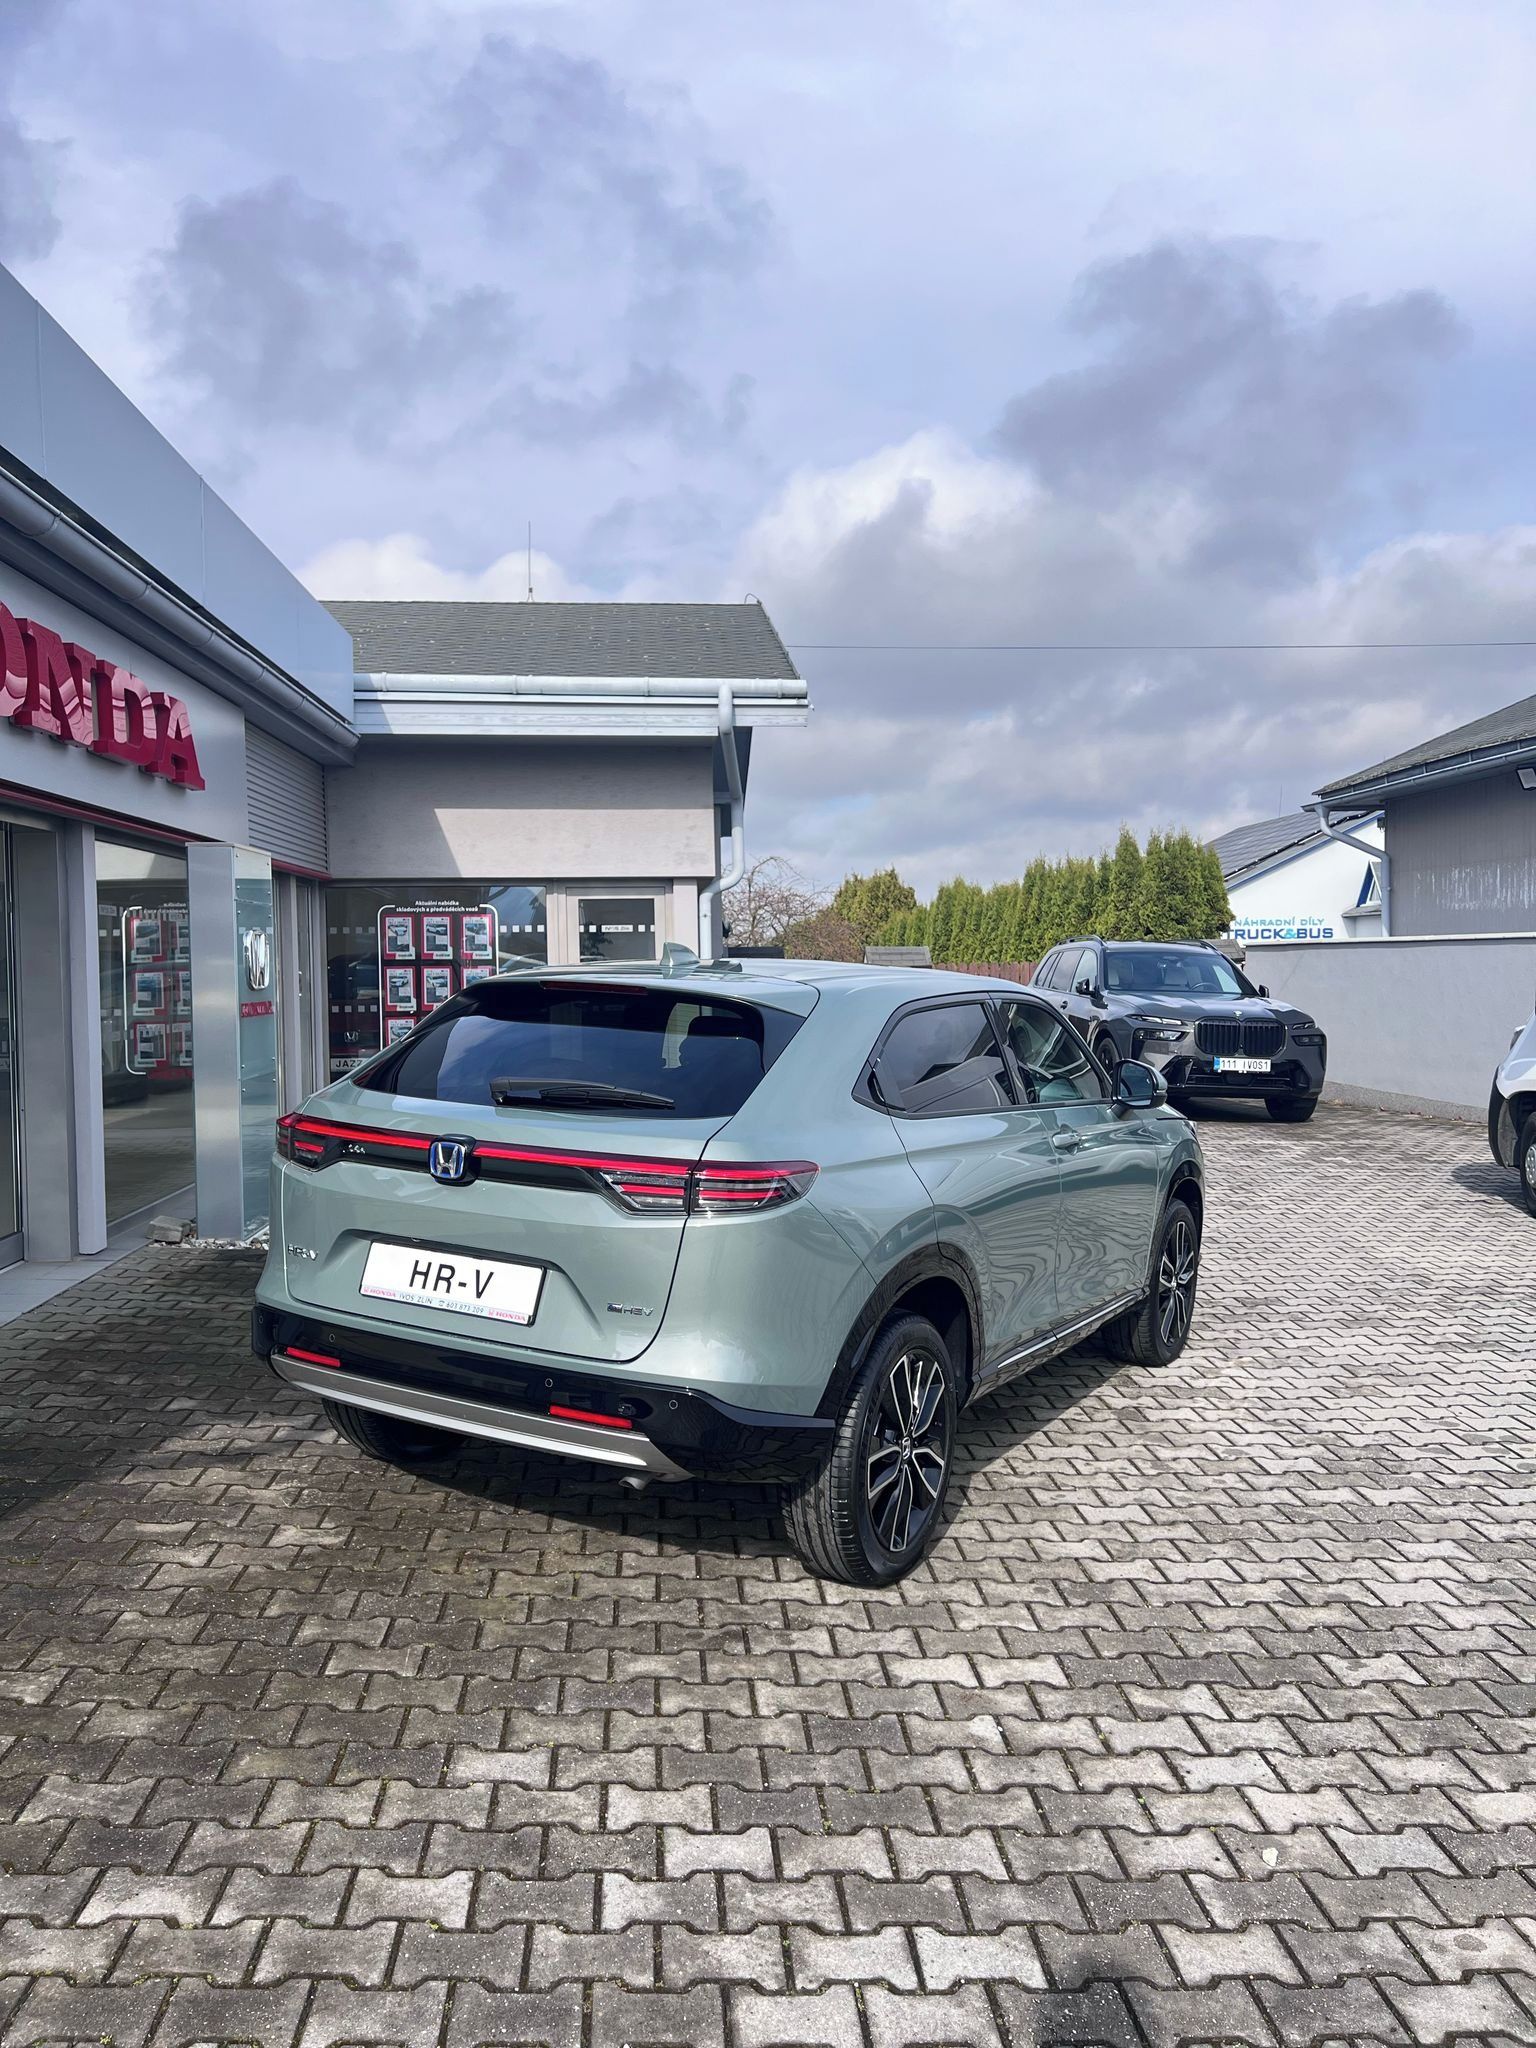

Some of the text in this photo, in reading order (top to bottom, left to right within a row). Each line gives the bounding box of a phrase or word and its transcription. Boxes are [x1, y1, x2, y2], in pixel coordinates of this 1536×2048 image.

[1235, 916, 1325, 926] NÁHRADNÍ DÍLY
[1221, 1060, 1268, 1070] 111 IVOS1
[409, 1260, 494, 1299] HR-V
[370, 1289, 396, 1298] HONDA
[495, 1311, 526, 1321] HONDA
